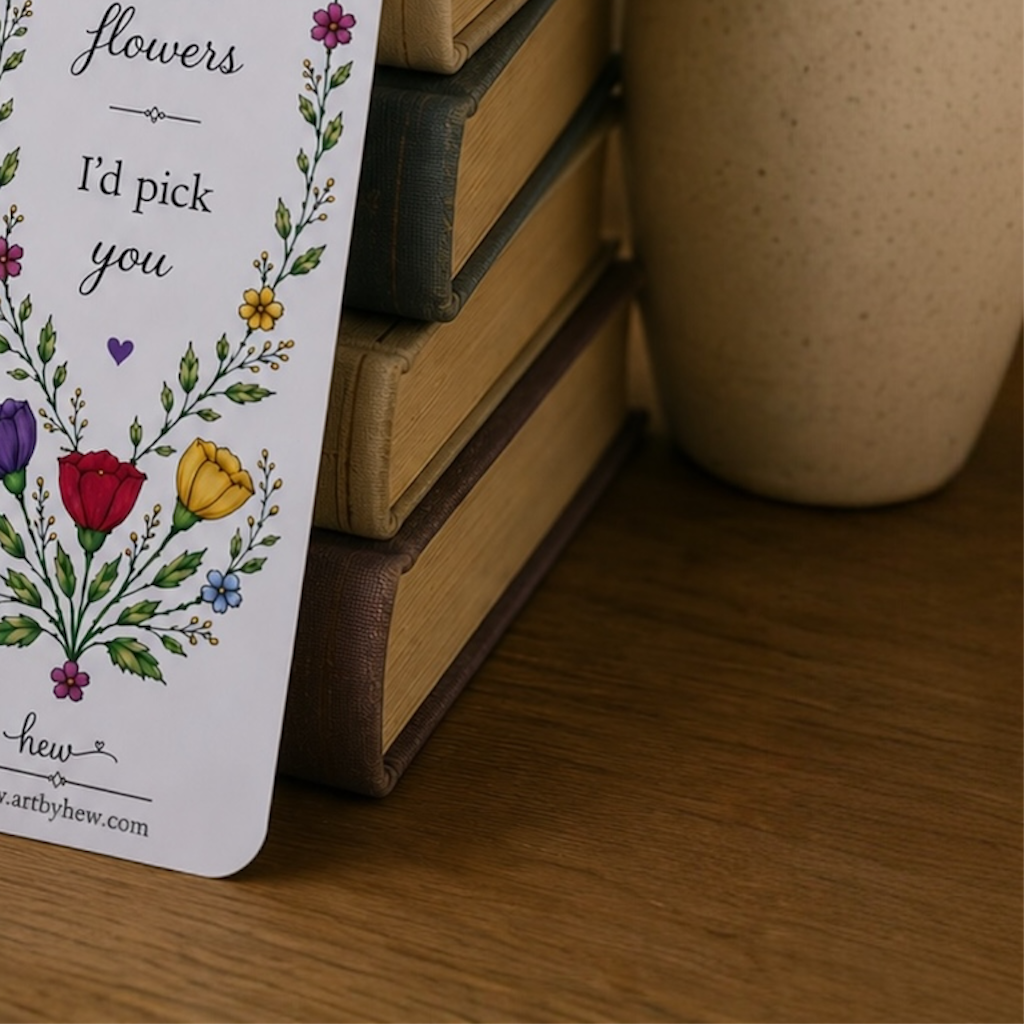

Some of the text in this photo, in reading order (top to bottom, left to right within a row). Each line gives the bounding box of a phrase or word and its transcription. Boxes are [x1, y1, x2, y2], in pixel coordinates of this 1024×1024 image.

[70, 2, 244, 77] flowers
[77, 155, 214, 215] I’d pick
[78, 241, 174, 296] you
[3, 711, 118, 764] hew
